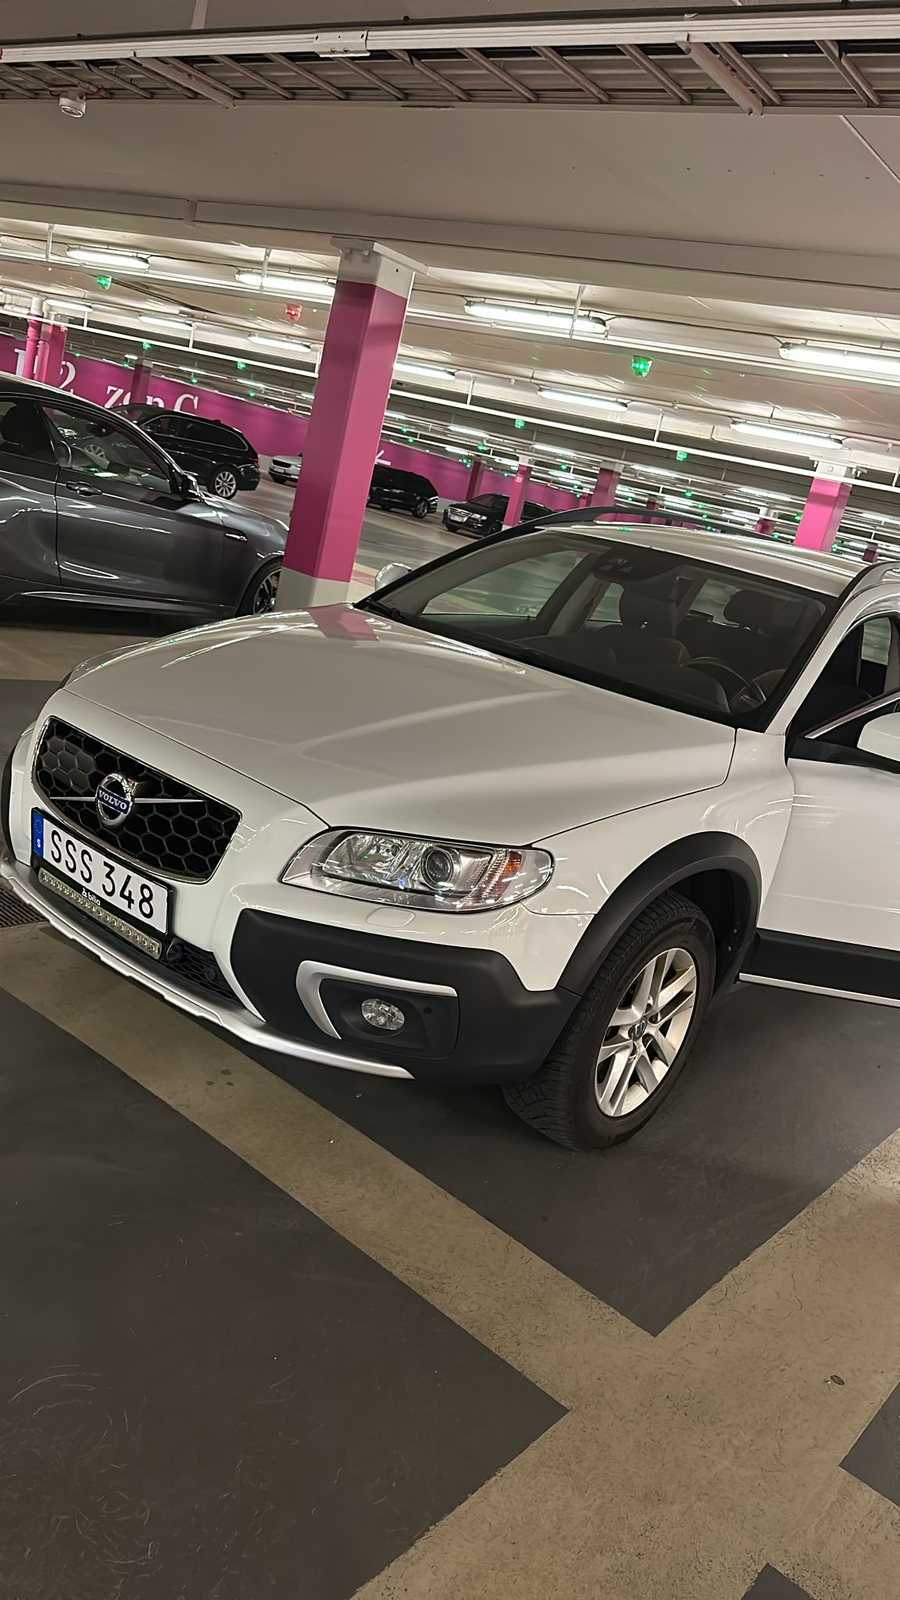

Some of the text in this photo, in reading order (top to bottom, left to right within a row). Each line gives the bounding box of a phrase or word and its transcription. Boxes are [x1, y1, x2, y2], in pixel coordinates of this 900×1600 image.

[98, 789, 127, 810] VOLVO
[37, 838, 41, 848] S
[50, 829, 154, 919] SSS 348
